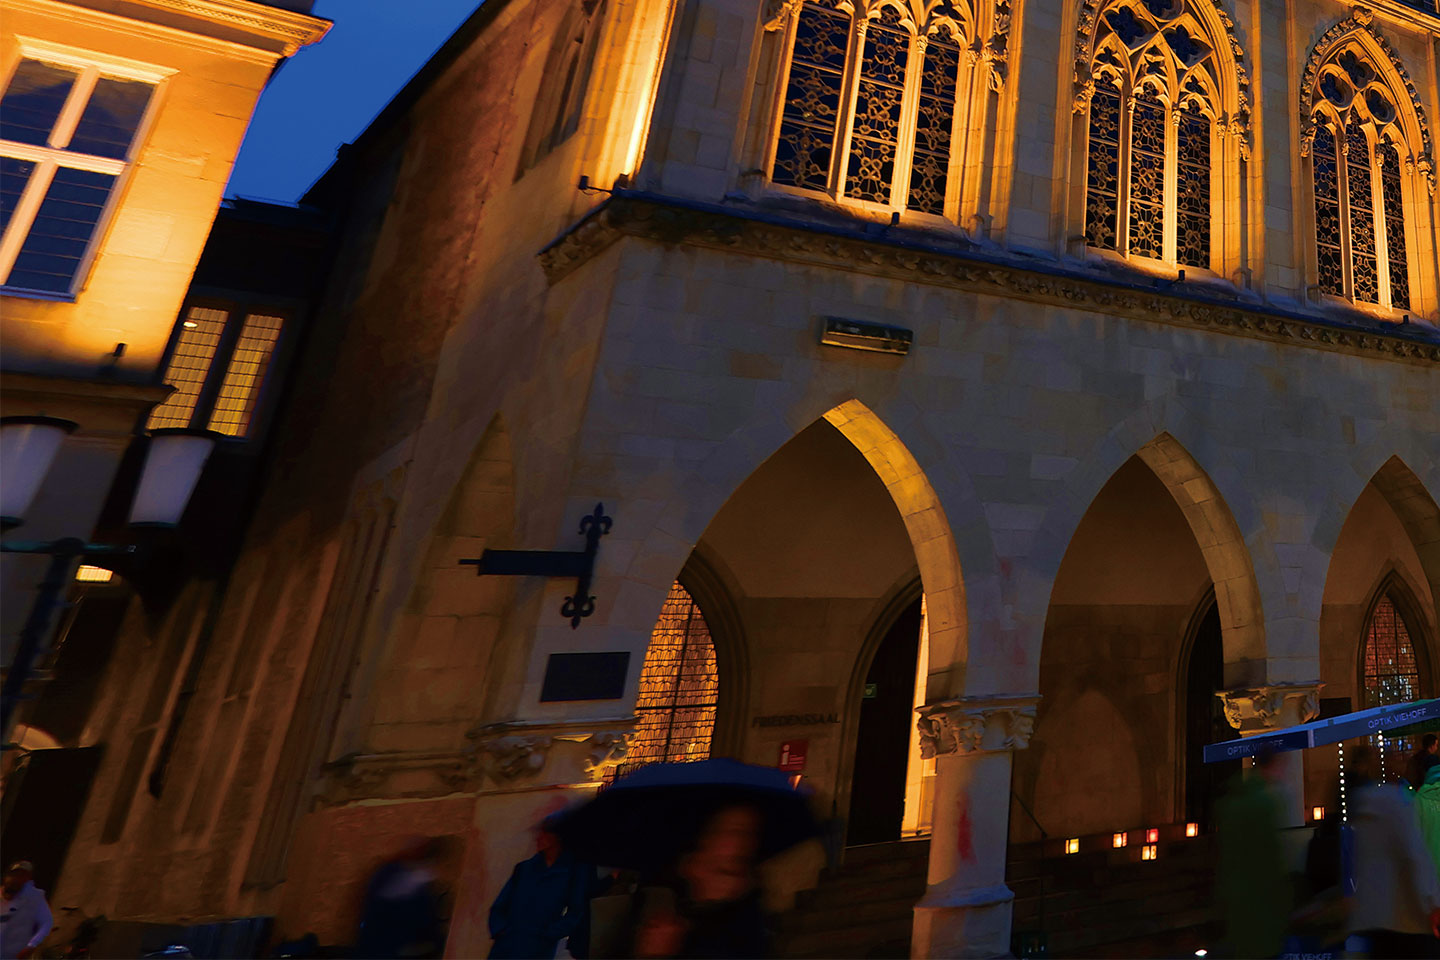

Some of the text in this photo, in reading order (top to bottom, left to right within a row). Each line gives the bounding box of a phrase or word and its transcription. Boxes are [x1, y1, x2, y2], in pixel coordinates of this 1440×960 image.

[1367, 716, 1393, 729] OPTIK
[1393, 707, 1427, 722] VIEHOFF
[1226, 744, 1250, 756] OPTIK
